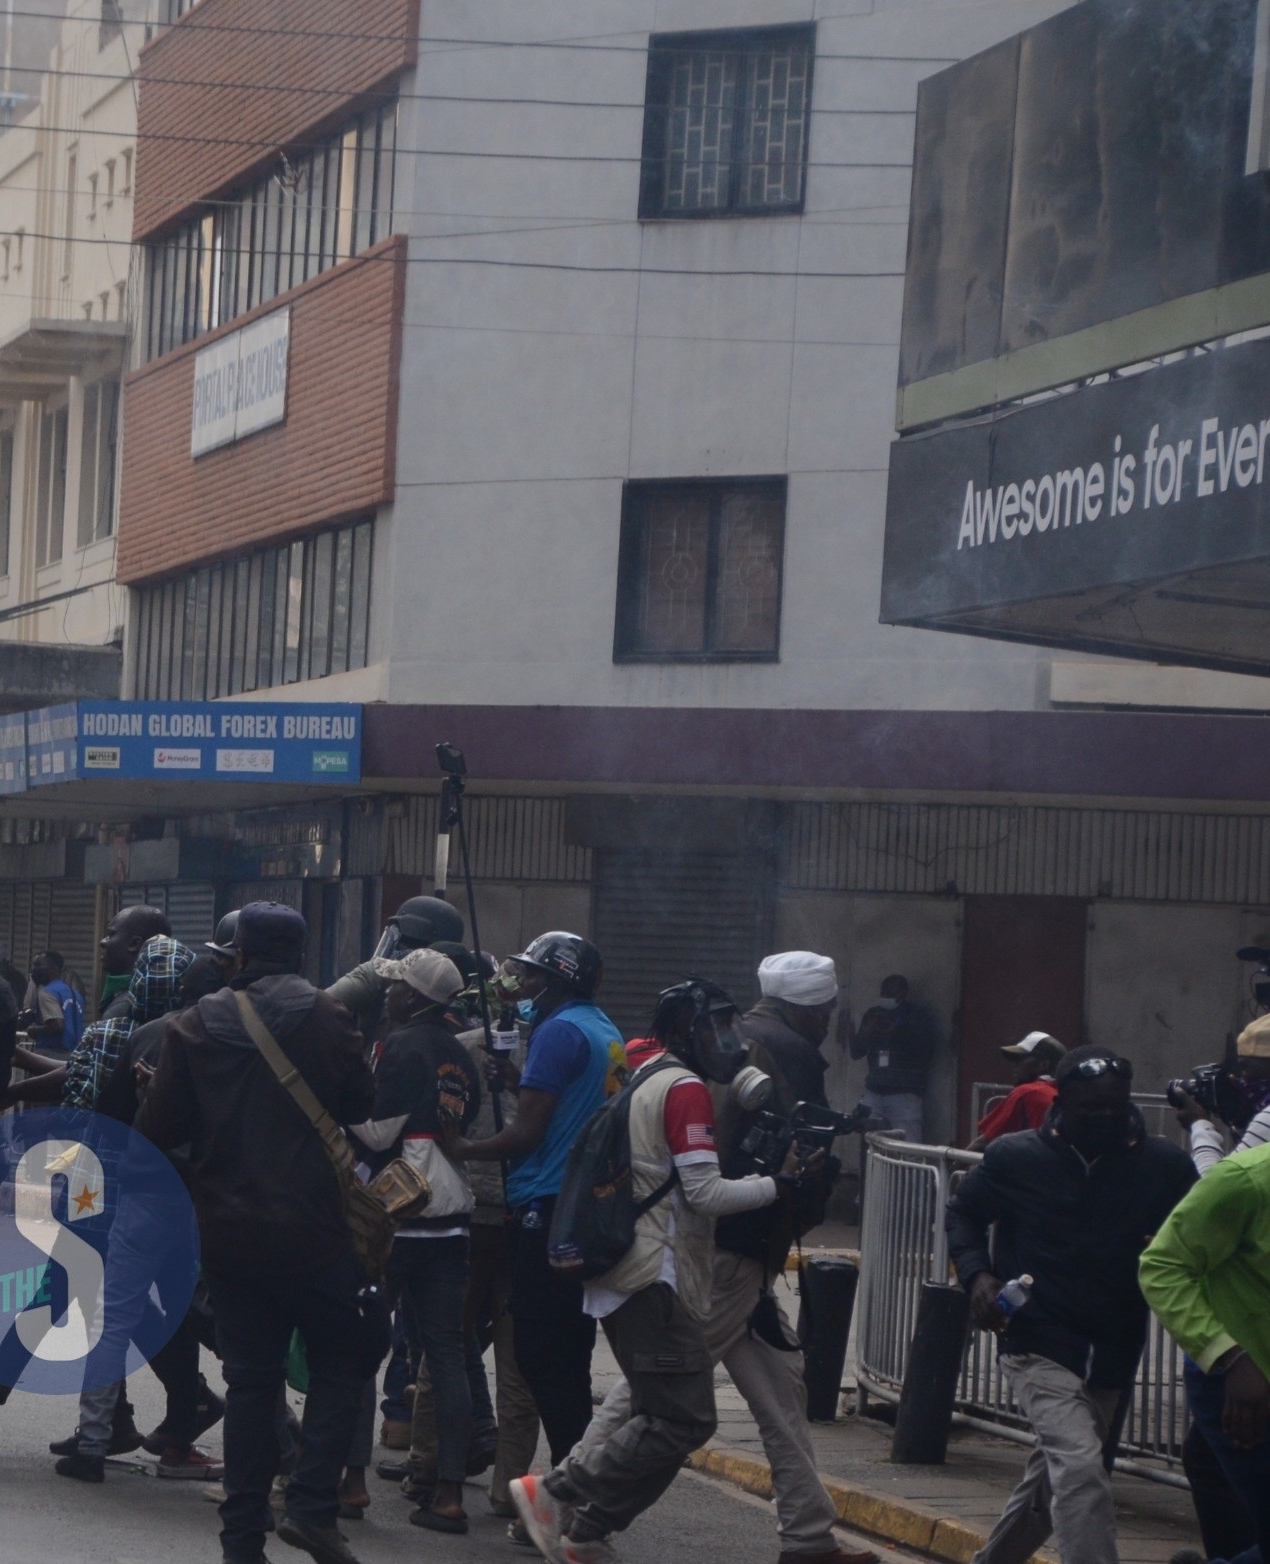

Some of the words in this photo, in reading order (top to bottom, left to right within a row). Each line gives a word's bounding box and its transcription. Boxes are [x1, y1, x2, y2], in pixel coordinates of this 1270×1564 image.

[957, 461, 1105, 550] Awesome
[1110, 434, 1137, 517] is
[1143, 423, 1193, 509] for
[1197, 416, 1270, 498] Ever
[83, 713, 143, 736] HODAN
[148, 714, 215, 738] GLOBAL
[221, 715, 278, 739] FOREX
[283, 716, 356, 740] BUREAU
